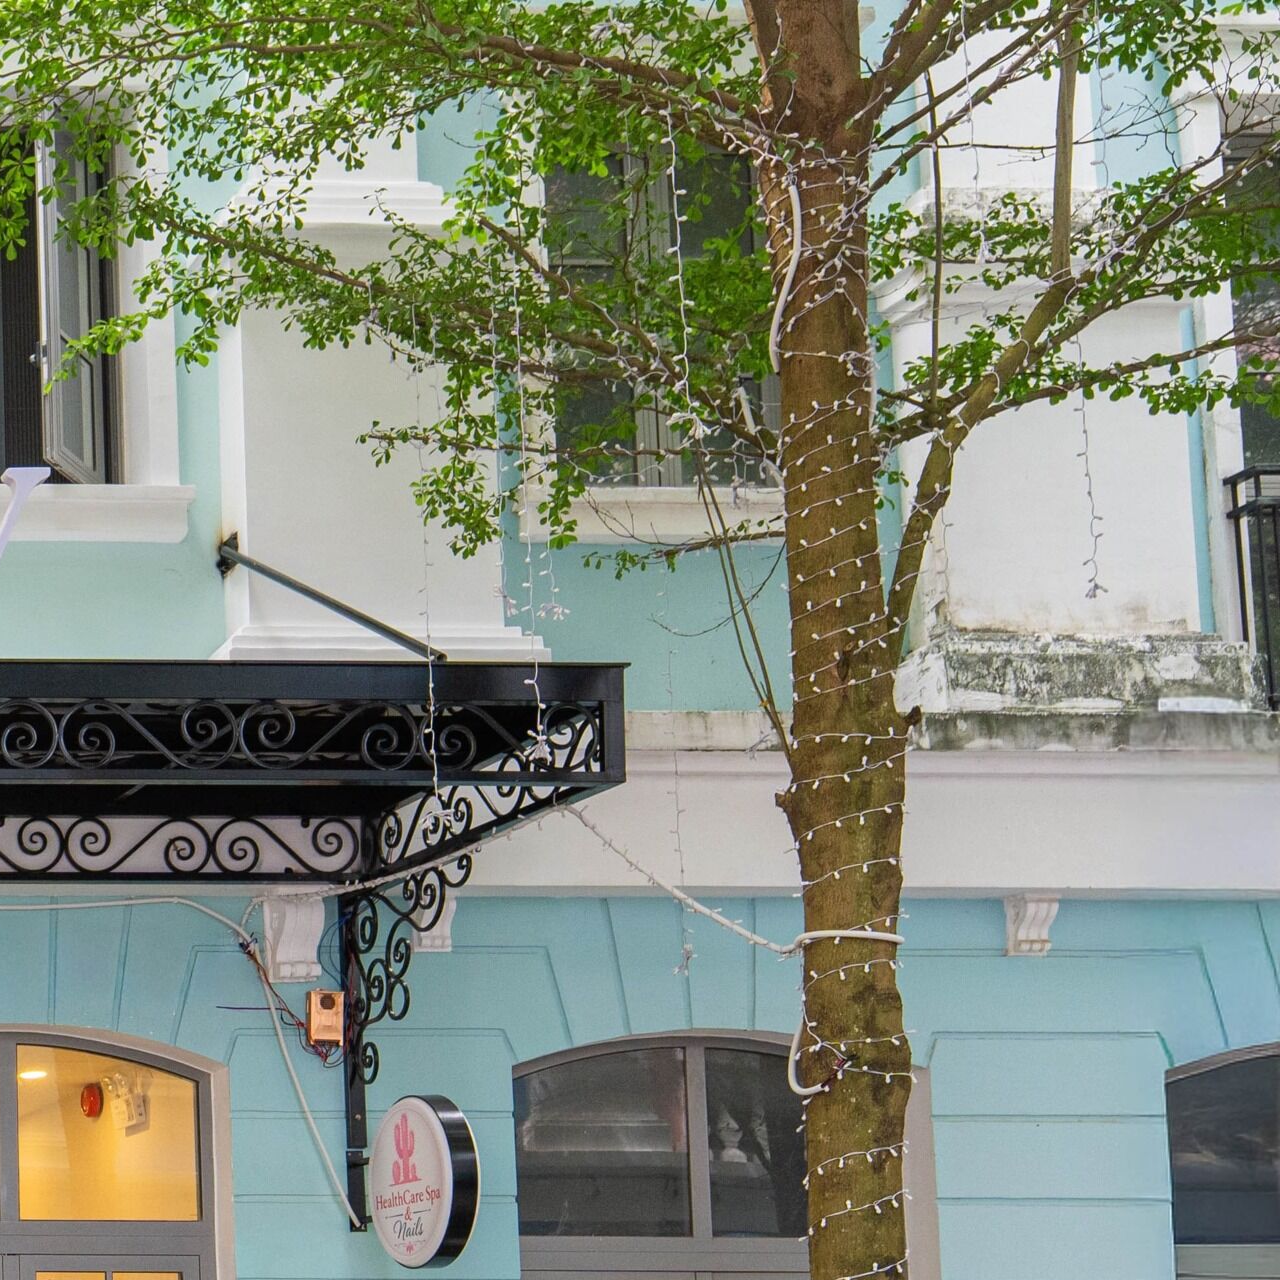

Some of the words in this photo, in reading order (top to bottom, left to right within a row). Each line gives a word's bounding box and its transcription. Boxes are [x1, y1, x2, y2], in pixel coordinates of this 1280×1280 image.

[425, 1184, 441, 1206] Spa
[404, 1205, 412, 1222] &
[393, 1216, 424, 1241] Nails
